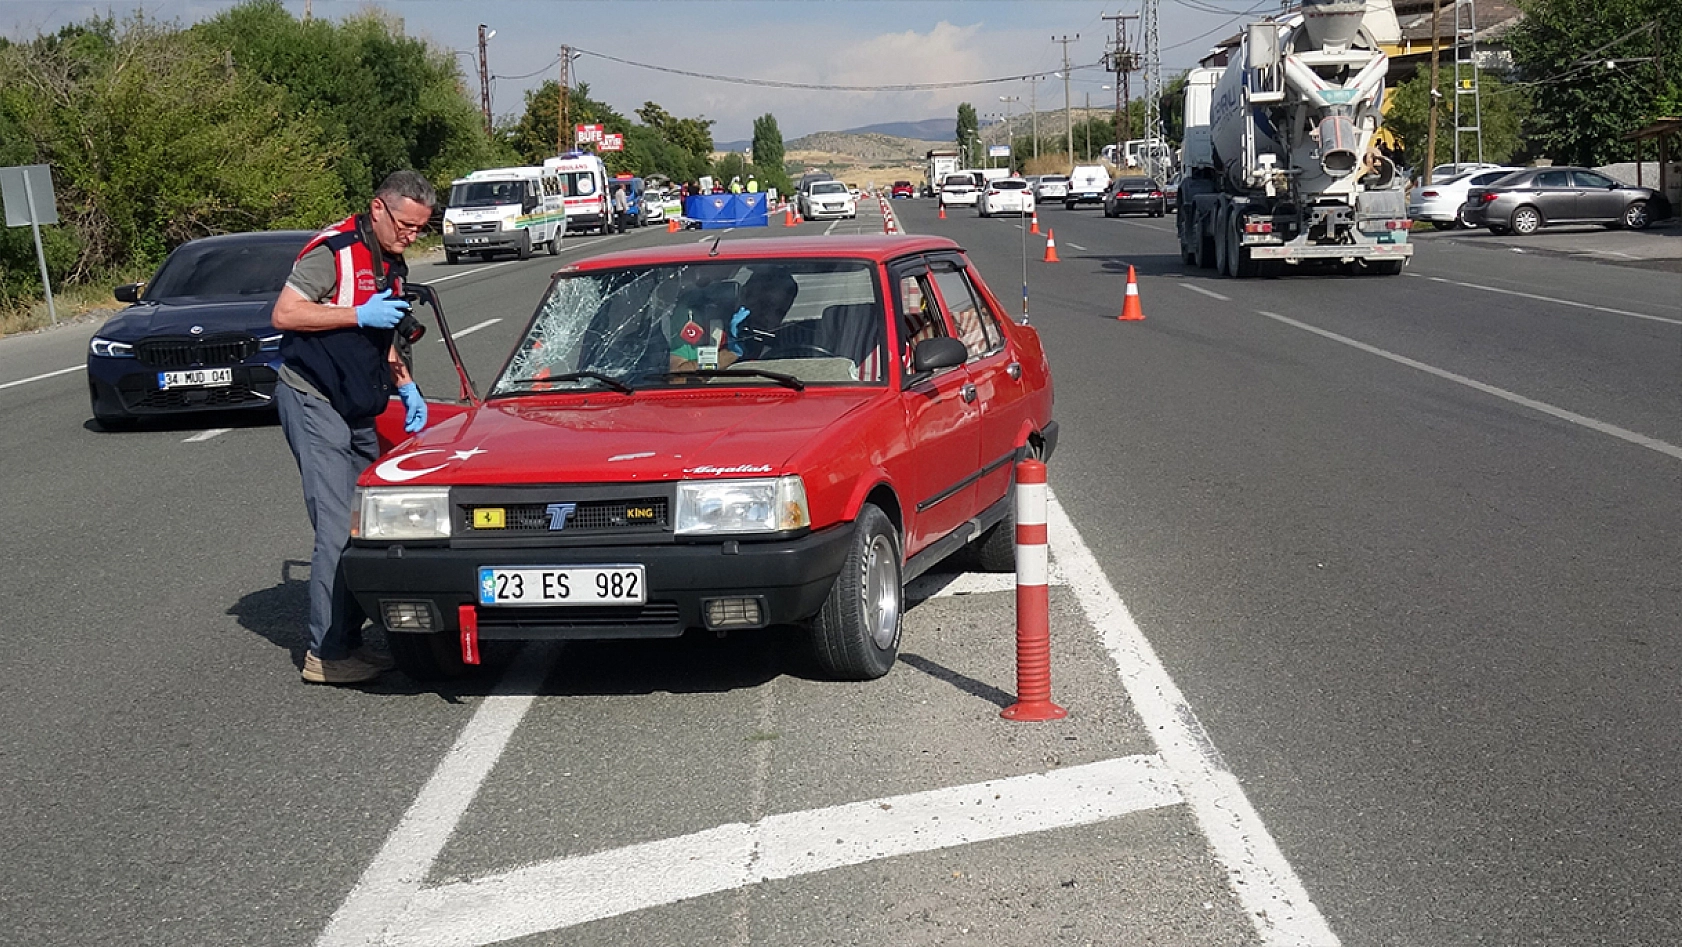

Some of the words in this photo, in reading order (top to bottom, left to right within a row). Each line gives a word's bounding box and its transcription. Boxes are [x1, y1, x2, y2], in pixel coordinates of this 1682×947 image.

[166, 373, 178, 384] 34
[212, 369, 231, 382] 041
[497, 573, 524, 599] 23
[542, 572, 570, 599] ES
[596, 572, 639, 599] 982
